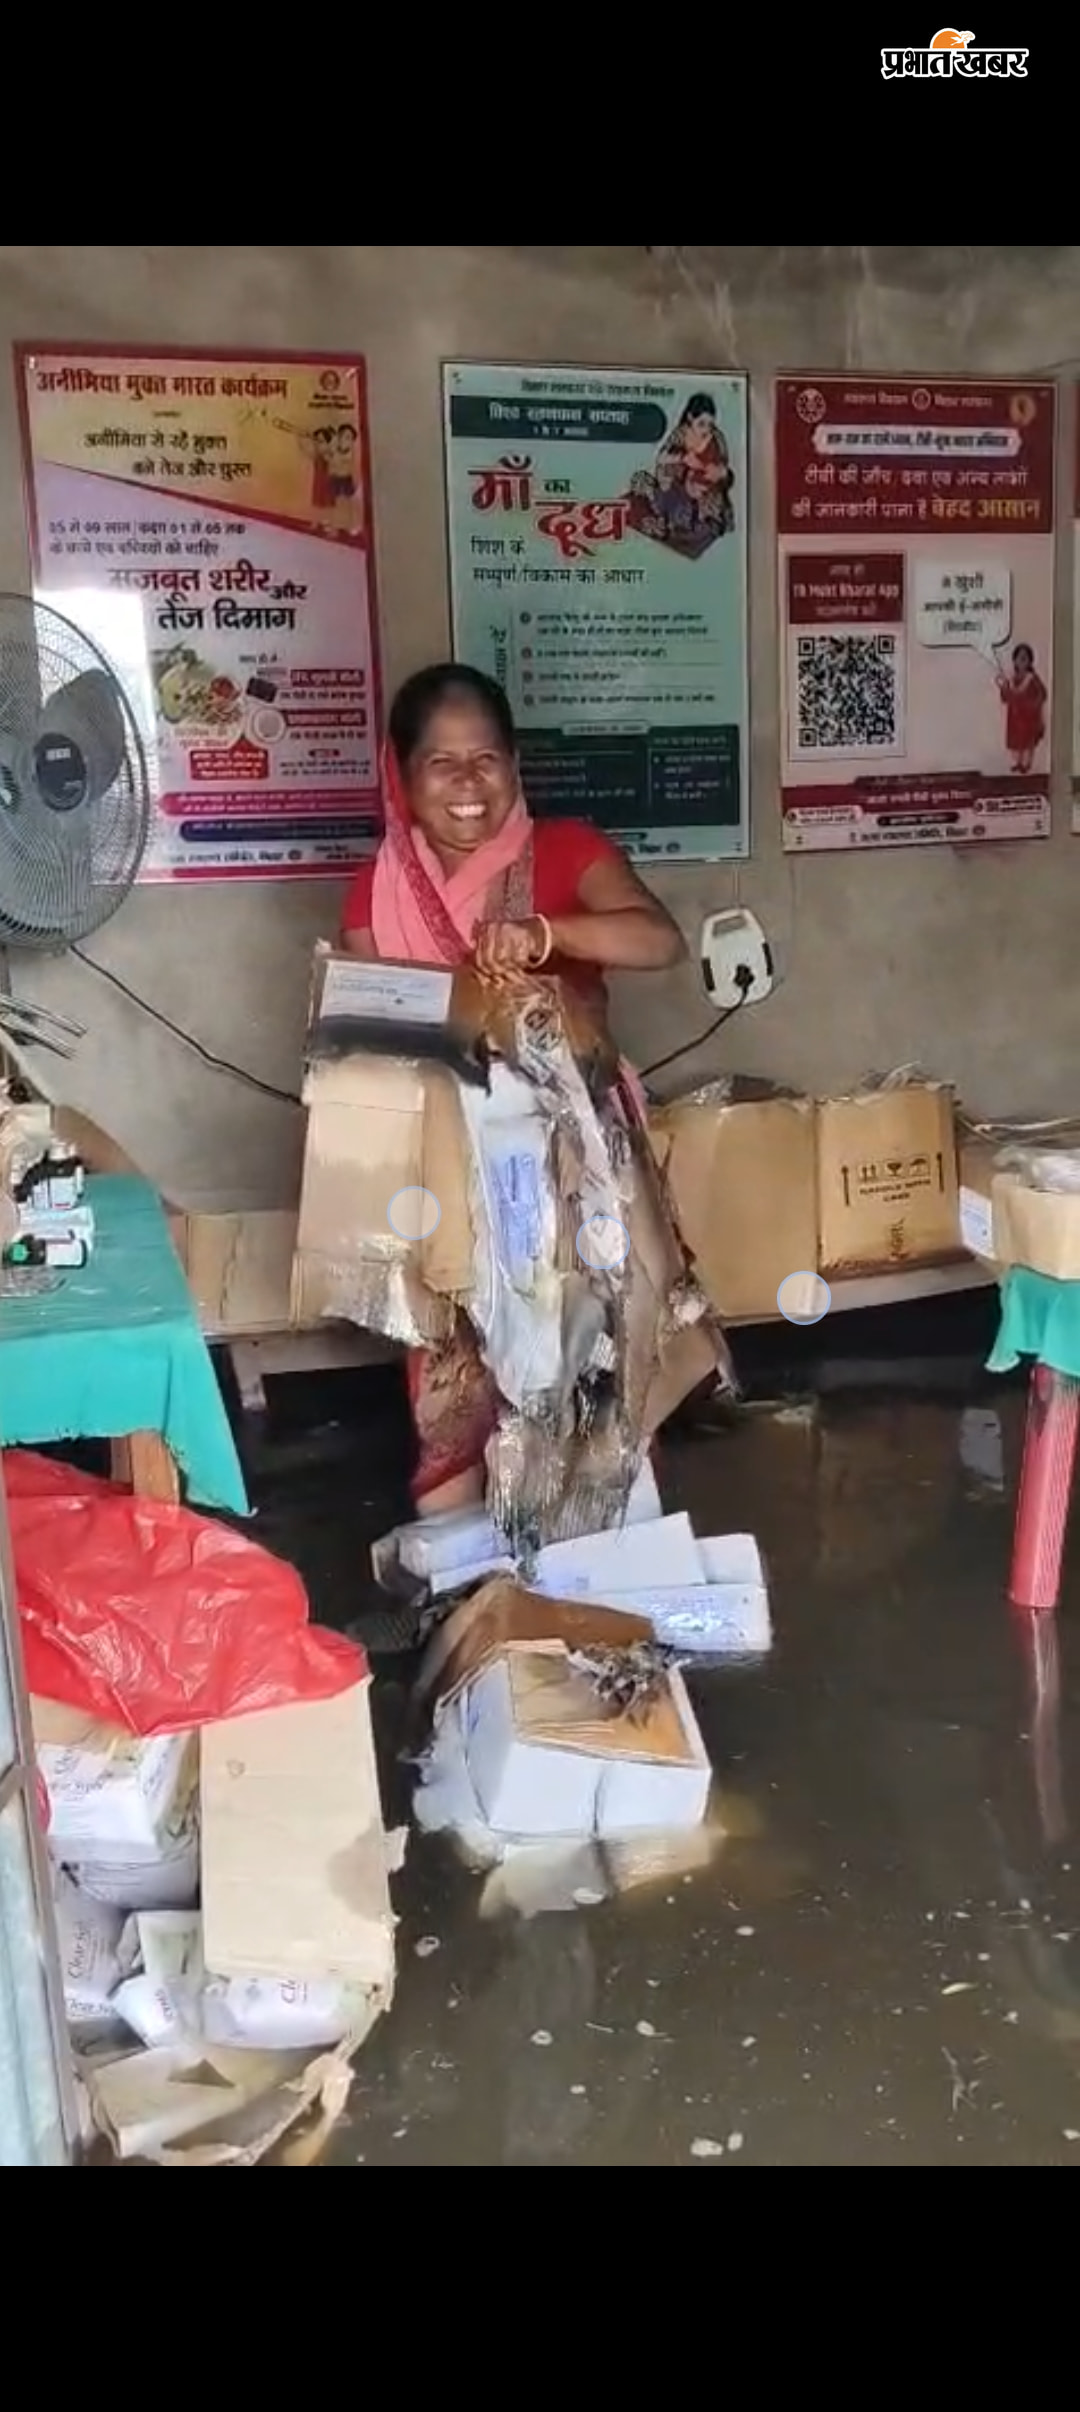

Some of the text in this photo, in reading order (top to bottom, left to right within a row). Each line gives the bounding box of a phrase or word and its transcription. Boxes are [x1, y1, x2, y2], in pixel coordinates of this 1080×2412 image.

[37, 367, 288, 400] अनीमिया मुक्त भारत कार्यक्रम
[467, 455, 534, 511] माँ
[543, 479, 570, 493] का
[805, 463, 835, 484] टीबी
[815, 496, 877, 518] जानकारी
[931, 492, 972, 518] बेहद
[977, 499, 1041, 519] आसान
[535, 501, 628, 557] दूध
[106, 558, 308, 602] मजबूत शरीर और
[575, 568, 596, 583] का
[602, 568, 646, 583] आधार
[156, 597, 296, 630] तेज दिमाग
